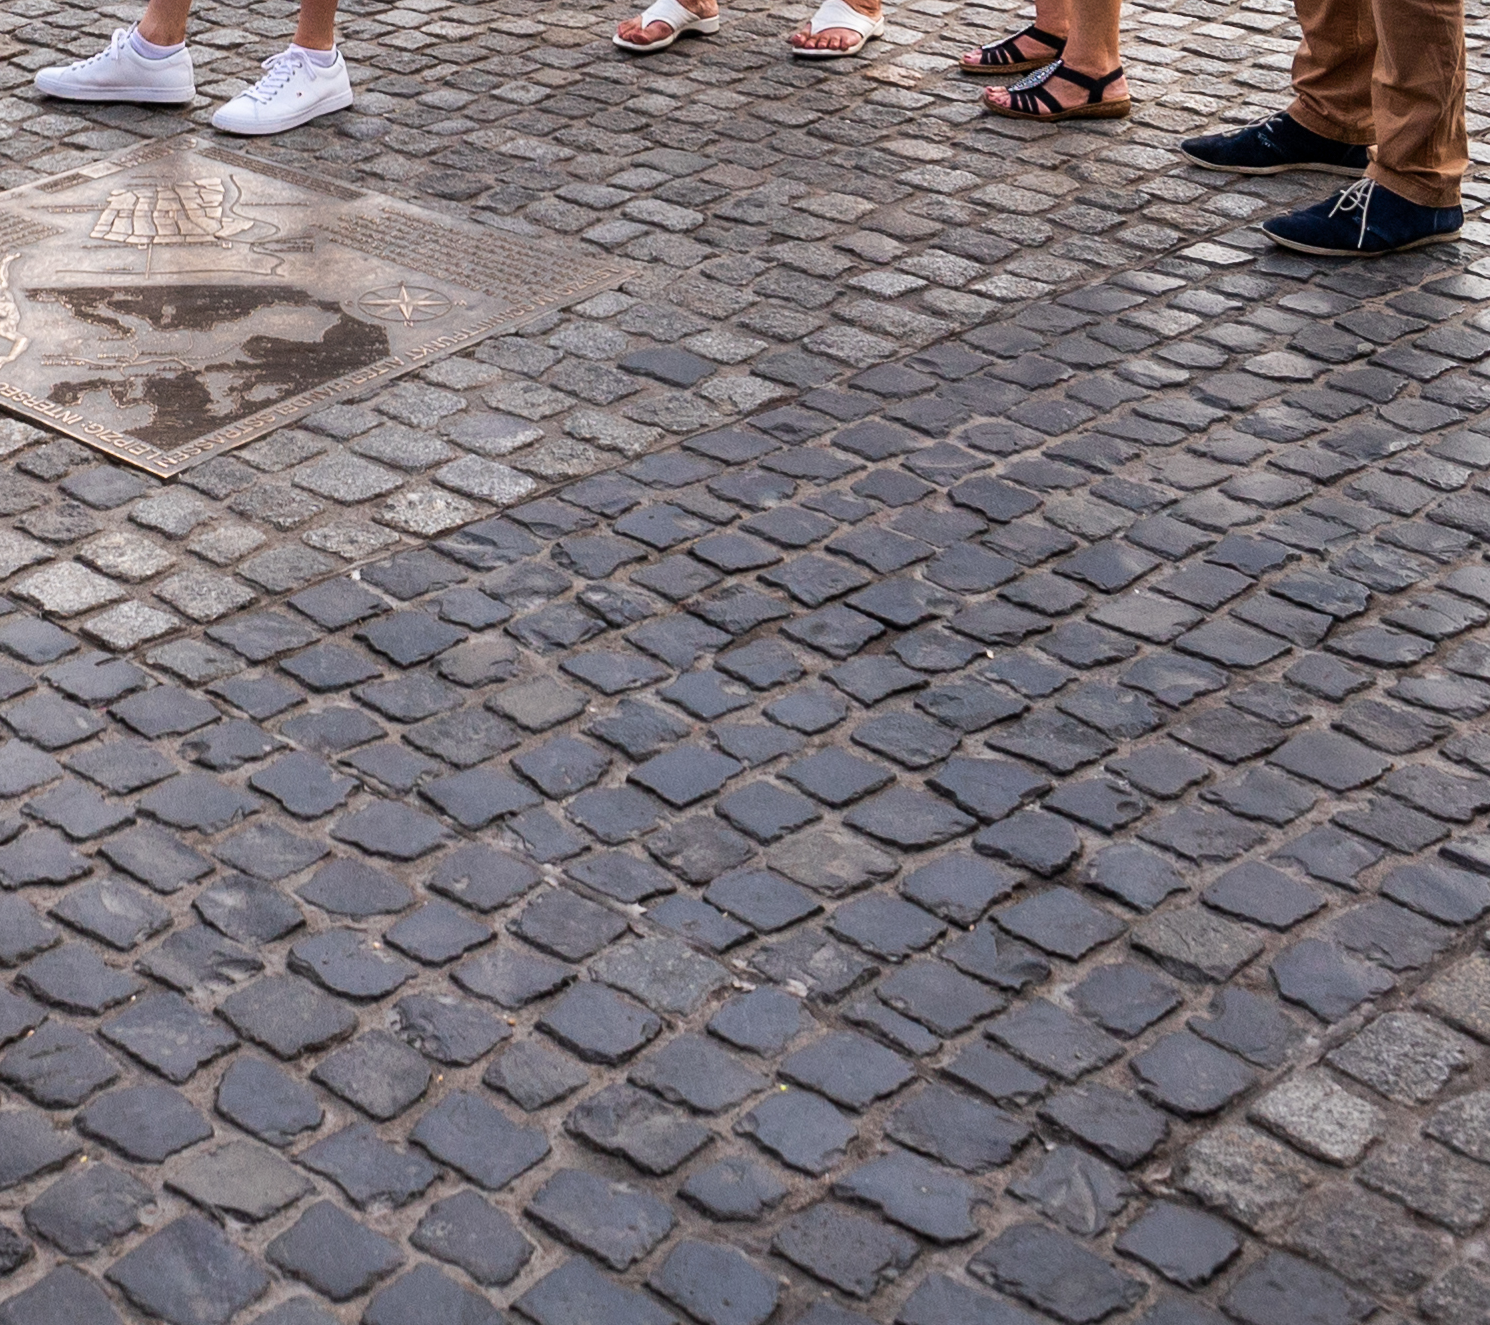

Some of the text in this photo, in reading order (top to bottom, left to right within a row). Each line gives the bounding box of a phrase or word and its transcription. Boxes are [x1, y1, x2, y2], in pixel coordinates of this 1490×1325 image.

[151, 266, 620, 470] LEIPZIG IM SCHNITTPUNKT ALTER HANDELSSTRASSEN
[83, 416, 158, 464] LEIPZIG:
